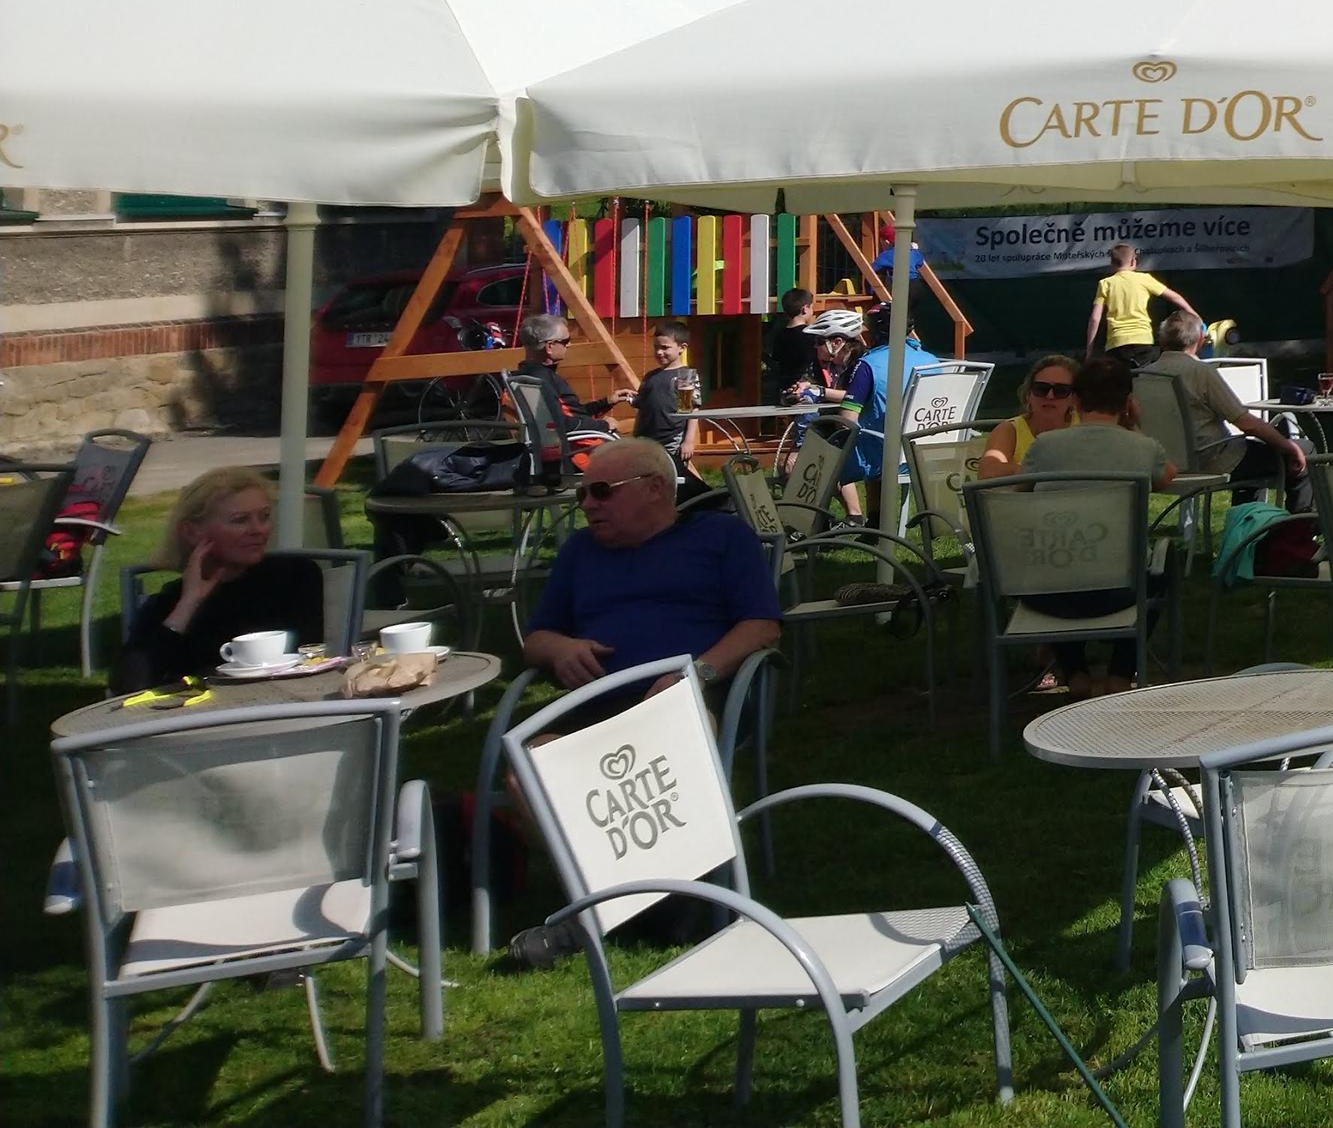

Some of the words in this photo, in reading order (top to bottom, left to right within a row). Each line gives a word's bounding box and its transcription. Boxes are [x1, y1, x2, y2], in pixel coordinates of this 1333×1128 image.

[1000, 96, 1163, 148] CARTE
[1180, 90, 1323, 142] D'OR
[975, 220, 1087, 252] Společně
[1094, 218, 1199, 242] můžeme
[1204, 217, 1250, 236] více
[914, 405, 957, 422] CARTE
[585, 754, 677, 828] CARTE
[605, 798, 688, 861] D'OR
